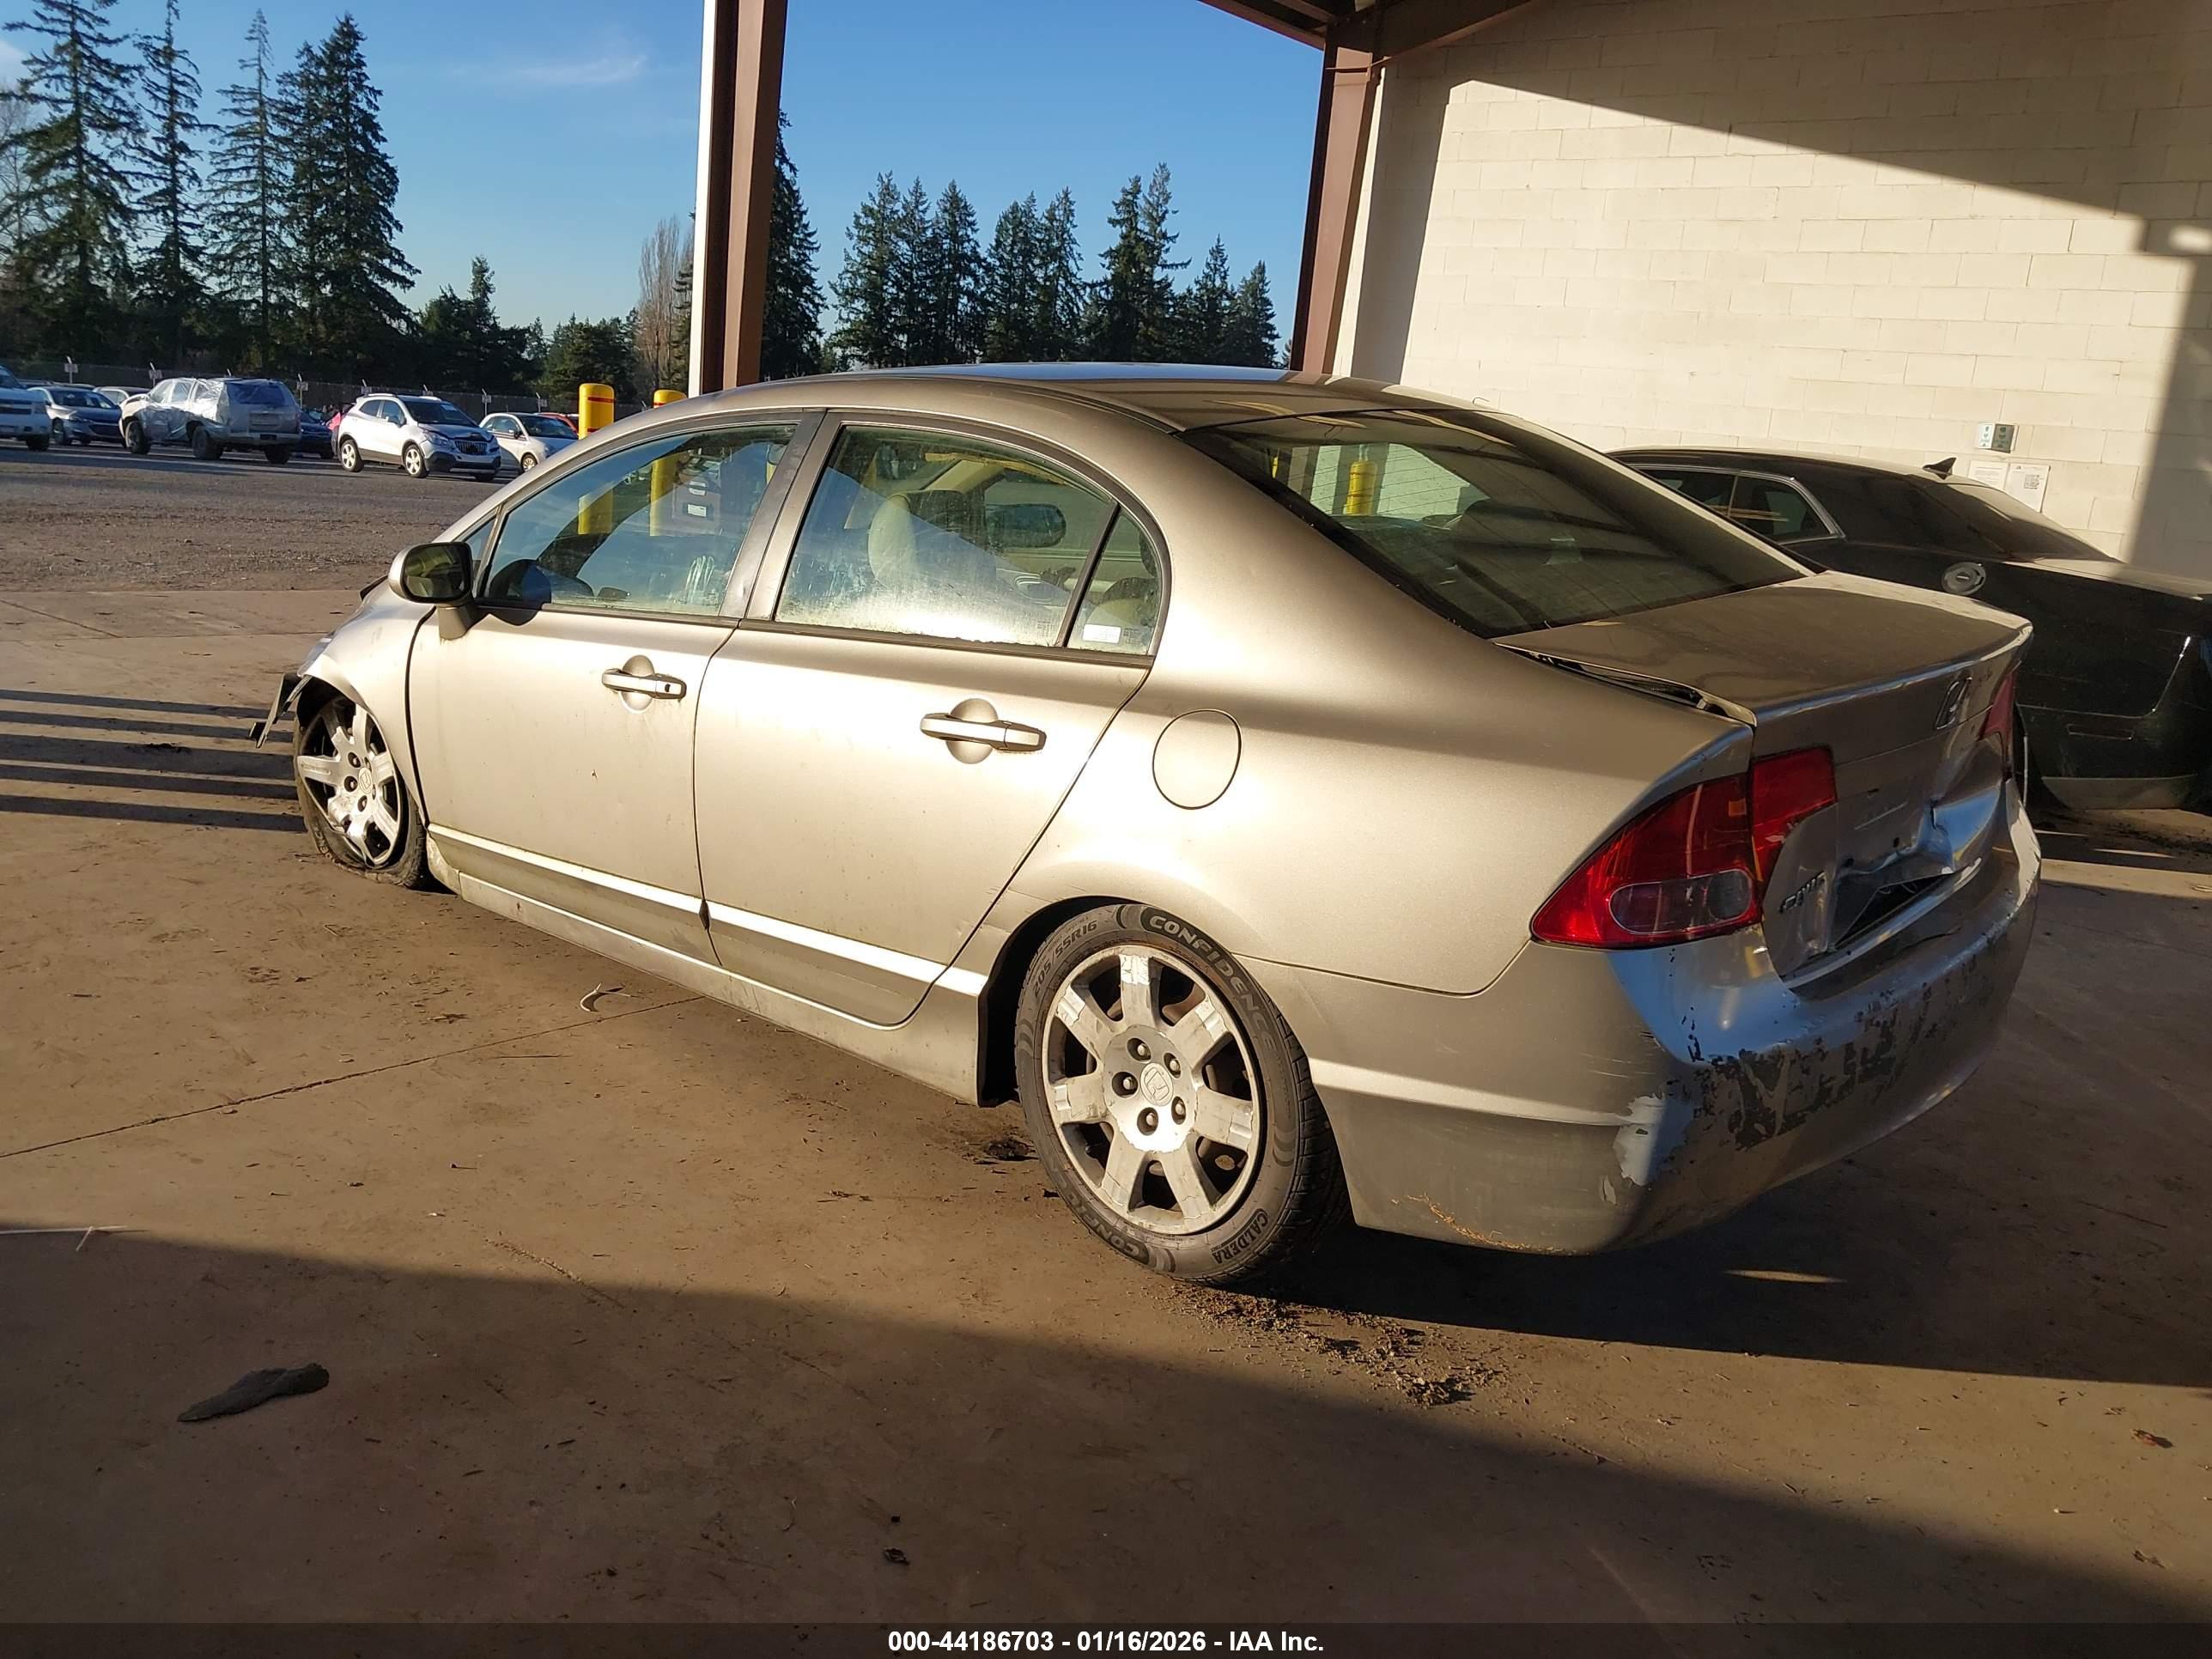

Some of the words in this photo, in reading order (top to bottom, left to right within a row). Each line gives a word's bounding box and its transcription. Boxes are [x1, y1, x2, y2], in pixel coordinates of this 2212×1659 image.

[1033, 921, 1098, 997] 205/55R16
[1149, 915, 1278, 1051] CONFIDENCE
[1212, 1212, 1269, 1265] CALDERA
